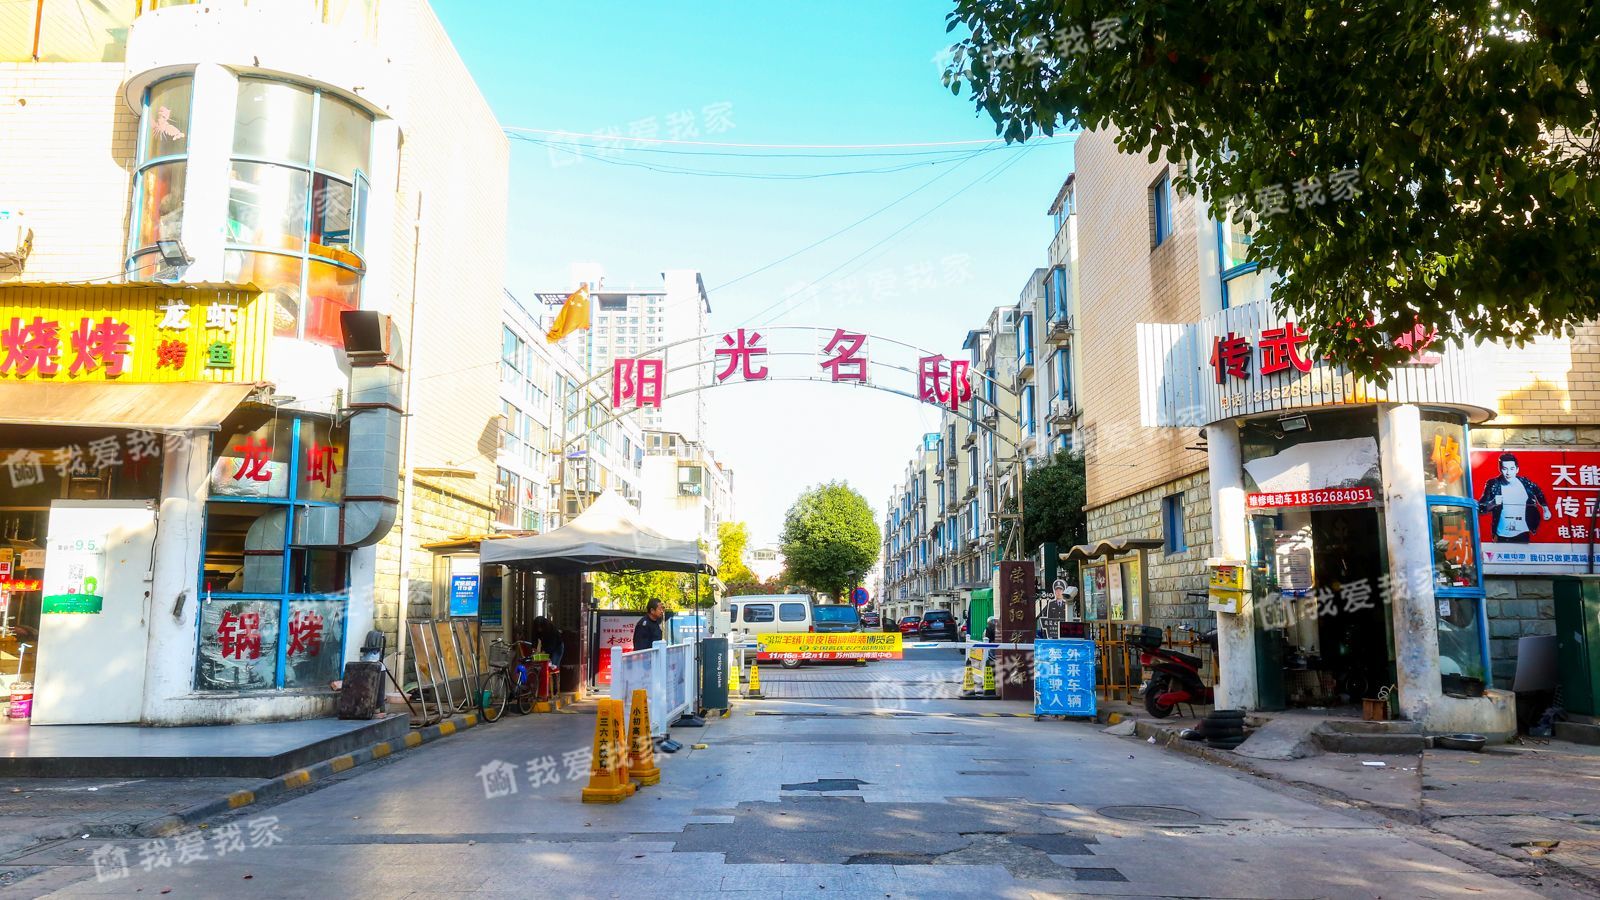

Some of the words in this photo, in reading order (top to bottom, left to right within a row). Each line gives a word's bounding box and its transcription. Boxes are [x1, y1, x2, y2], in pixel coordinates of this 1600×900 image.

[159, 300, 238, 331] 龙虾
[1, 316, 130, 377] 烧烤
[156, 340, 235, 369] 烤鱼
[612, 328, 972, 412] 阳光名邸
[233, 436, 338, 488] 龙虾
[1551, 465, 1600, 486] 天能
[1530, 553, 1600, 563] 我们只做更高端
[1066, 648, 1083, 707] 外来车辆
